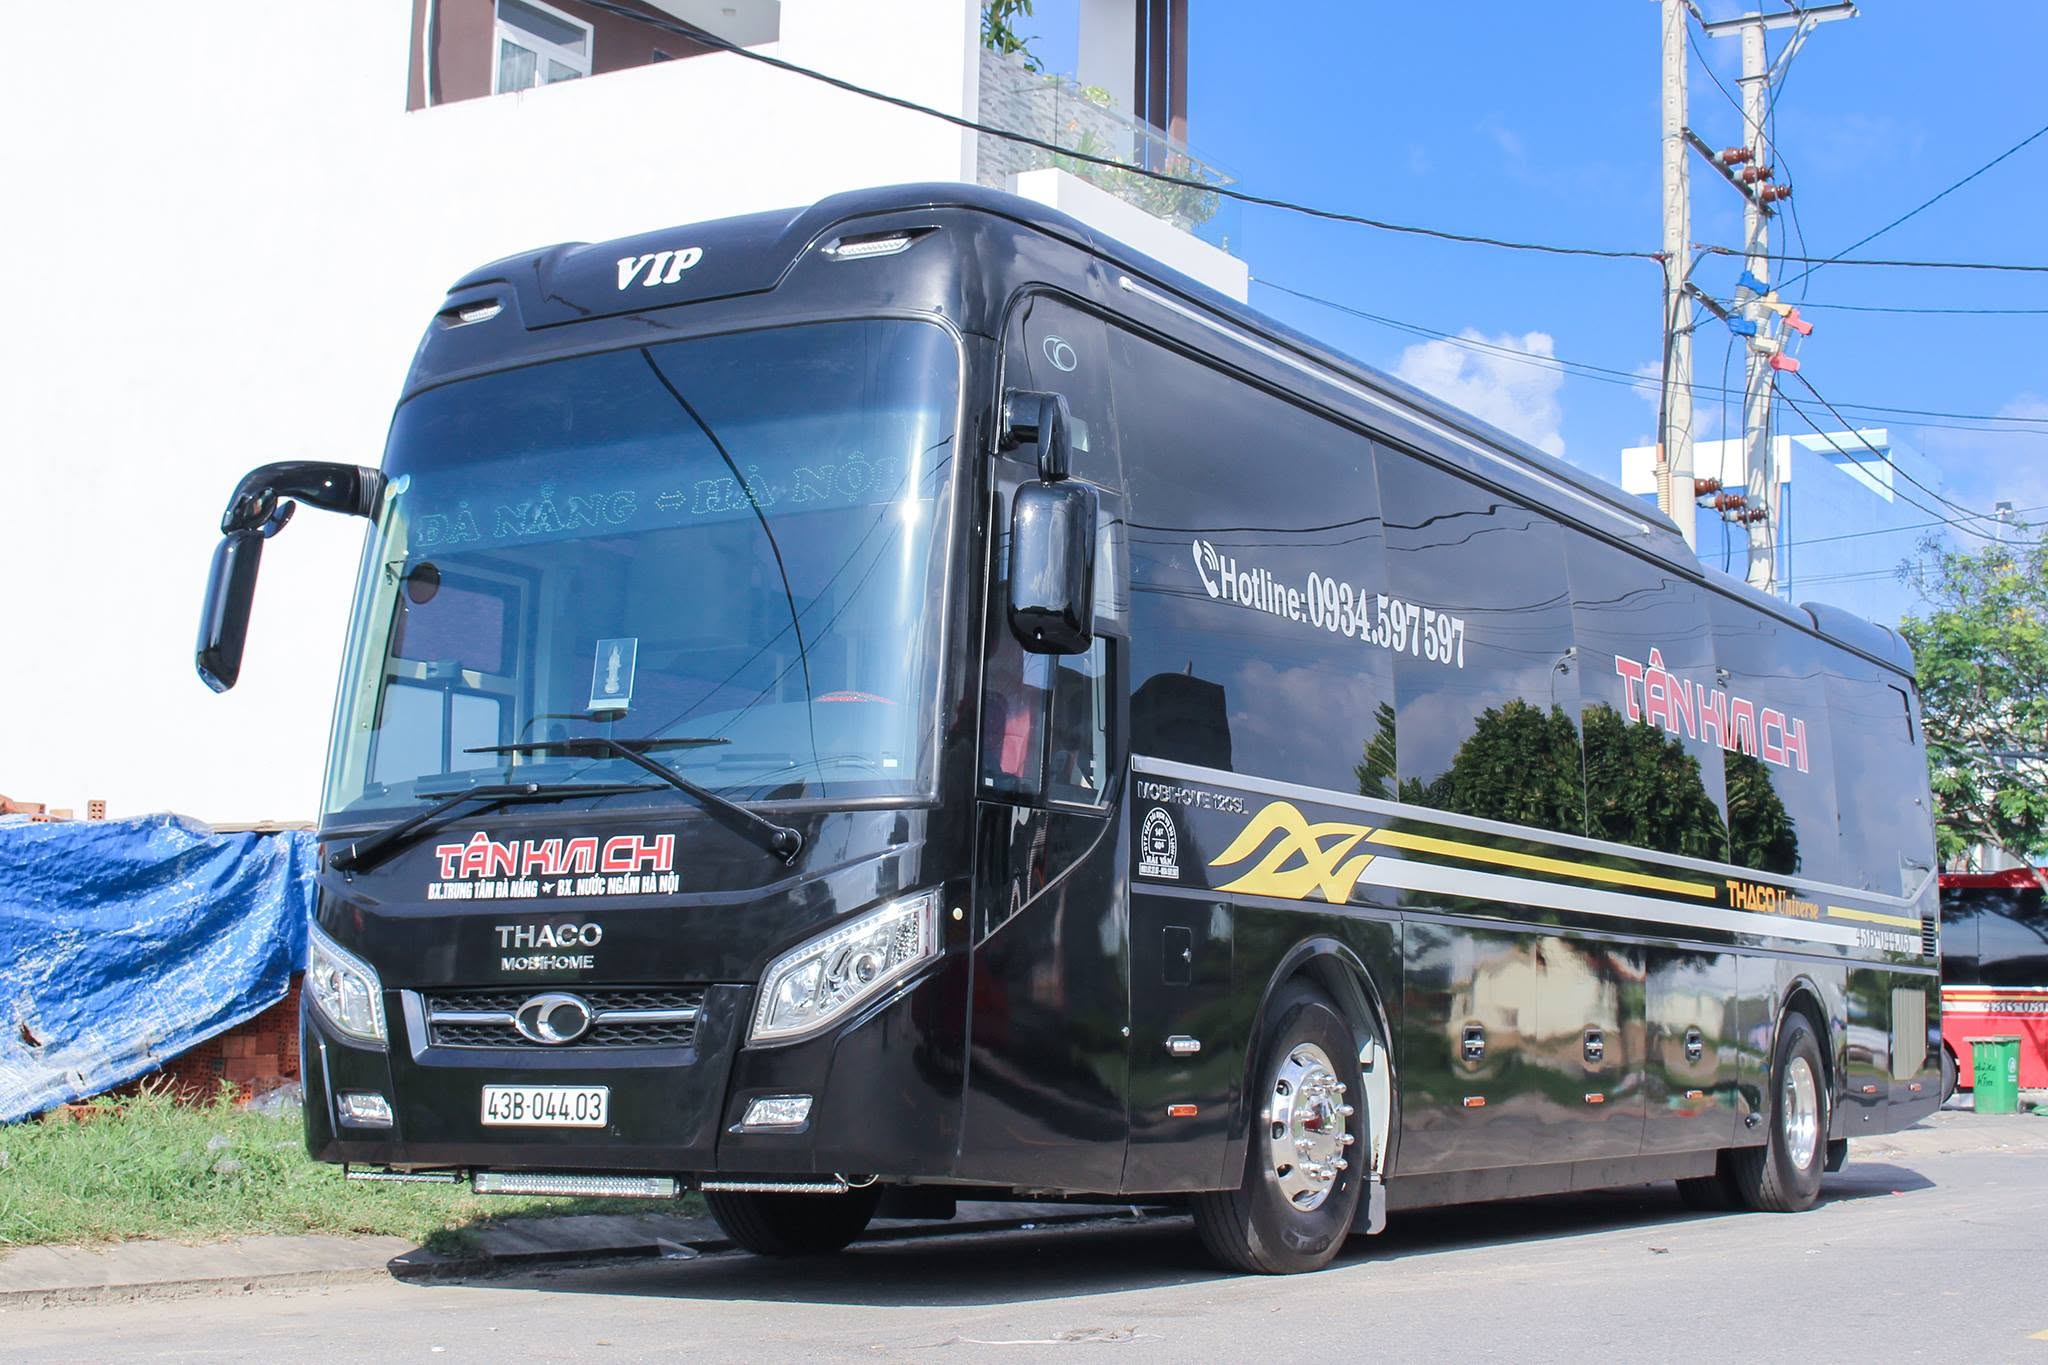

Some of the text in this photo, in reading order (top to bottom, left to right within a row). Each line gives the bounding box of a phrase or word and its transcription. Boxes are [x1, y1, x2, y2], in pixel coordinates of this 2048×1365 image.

[616, 247, 703, 291] VIP
[691, 464, 775, 514] HÀ
[1615, 647, 1809, 774] TÂN KIM CHI
[1137, 781, 1212, 809] MOBIHOME
[436, 832, 676, 879] TÂN KIM CHI
[474, 879, 494, 899] TÂM
[495, 878, 509, 898] ĐÀ
[557, 879, 575, 897] BX.
[577, 873, 606, 896] NƯỚC
[641, 871, 657, 893] HÀ
[659, 870, 680, 895] NỘI
[1726, 880, 1775, 913] THACO
[495, 922, 603, 949] THACO
[501, 955, 594, 971] MOBIHOME
[488, 1092, 602, 1121] 43B-044.03
